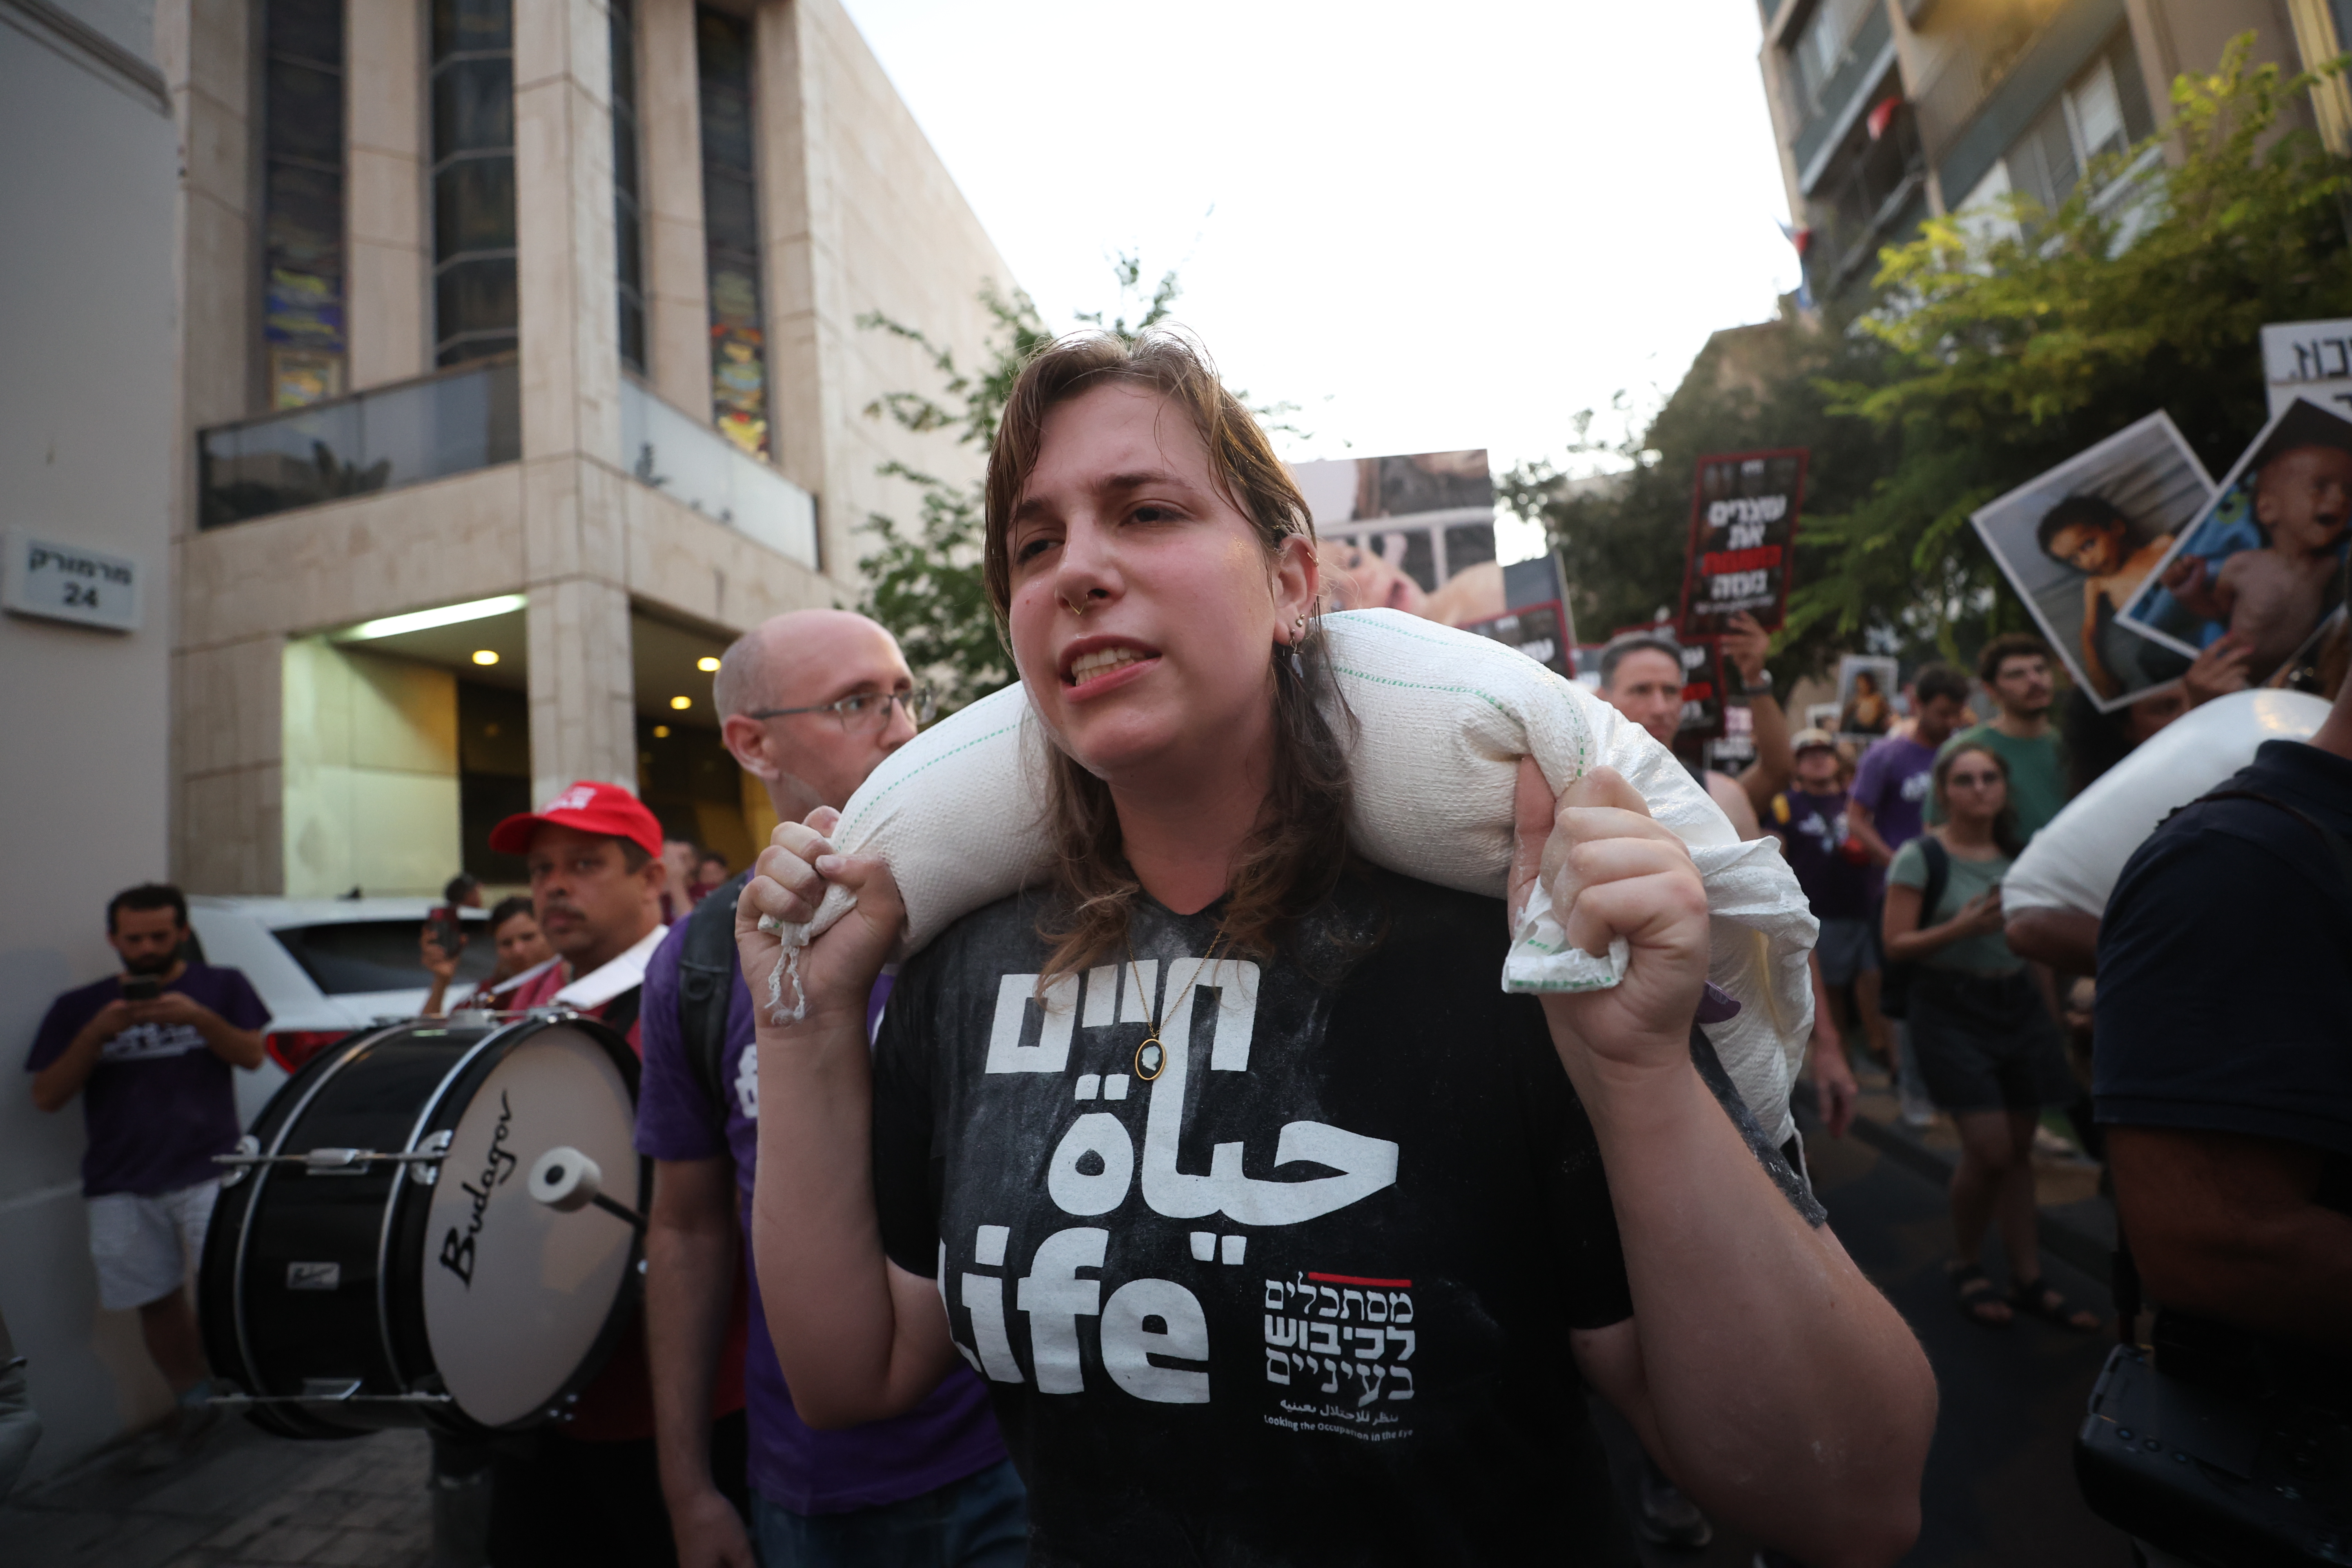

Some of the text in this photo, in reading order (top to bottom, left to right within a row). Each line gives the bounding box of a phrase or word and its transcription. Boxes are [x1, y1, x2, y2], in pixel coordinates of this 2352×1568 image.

[29, 548, 132, 585] מרמורק
[63, 581, 98, 609] 24
[985, 958, 1260, 1073] חיים
[1048, 958, 1399, 1265] حياة
[439, 1087, 517, 1289] Budagov
[937, 1225, 1210, 1403] ife
[1265, 1271, 1414, 1323] מסתכלים
[1265, 1314, 1416, 1360] לכיבוש
[1266, 1347, 1414, 1407] בעיניים
[1264, 1414, 1413, 1441] Looking the Occupation in the Eye
